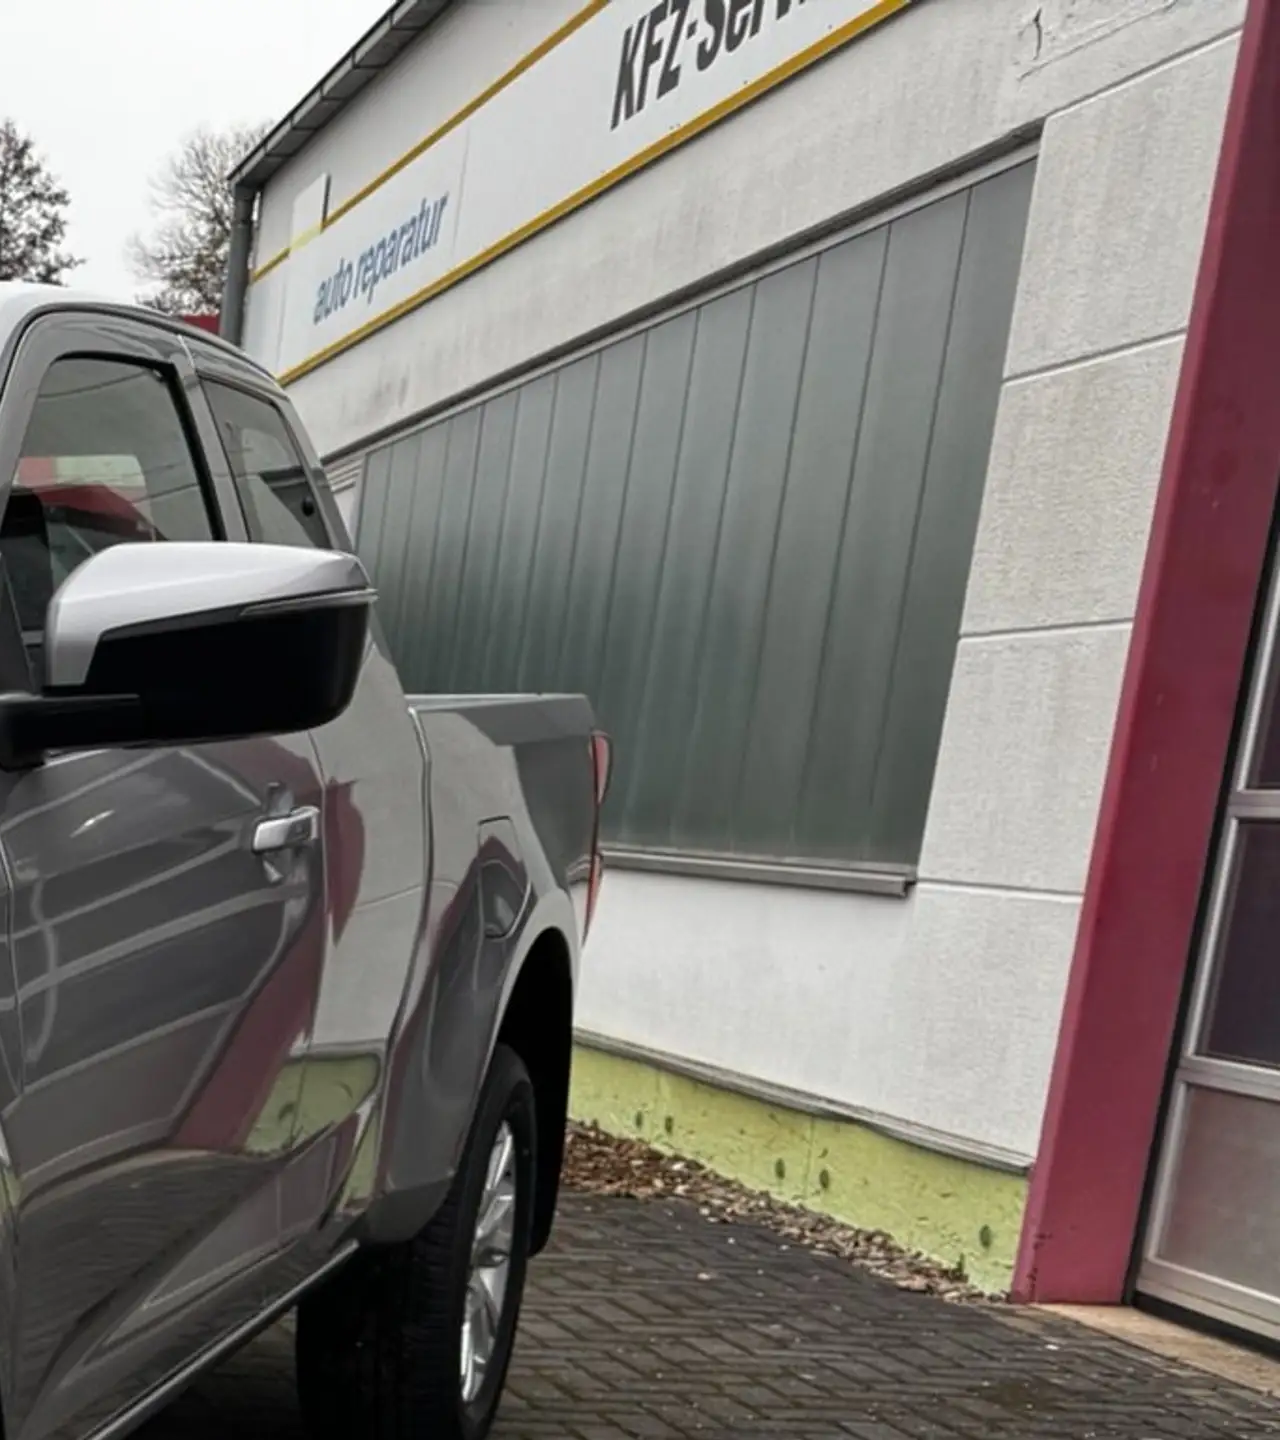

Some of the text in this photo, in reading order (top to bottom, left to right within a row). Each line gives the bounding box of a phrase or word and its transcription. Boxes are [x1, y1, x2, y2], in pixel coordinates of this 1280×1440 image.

[610, 0, 806, 131] KFZ-Ser
[313, 190, 449, 326] auto reparatur
